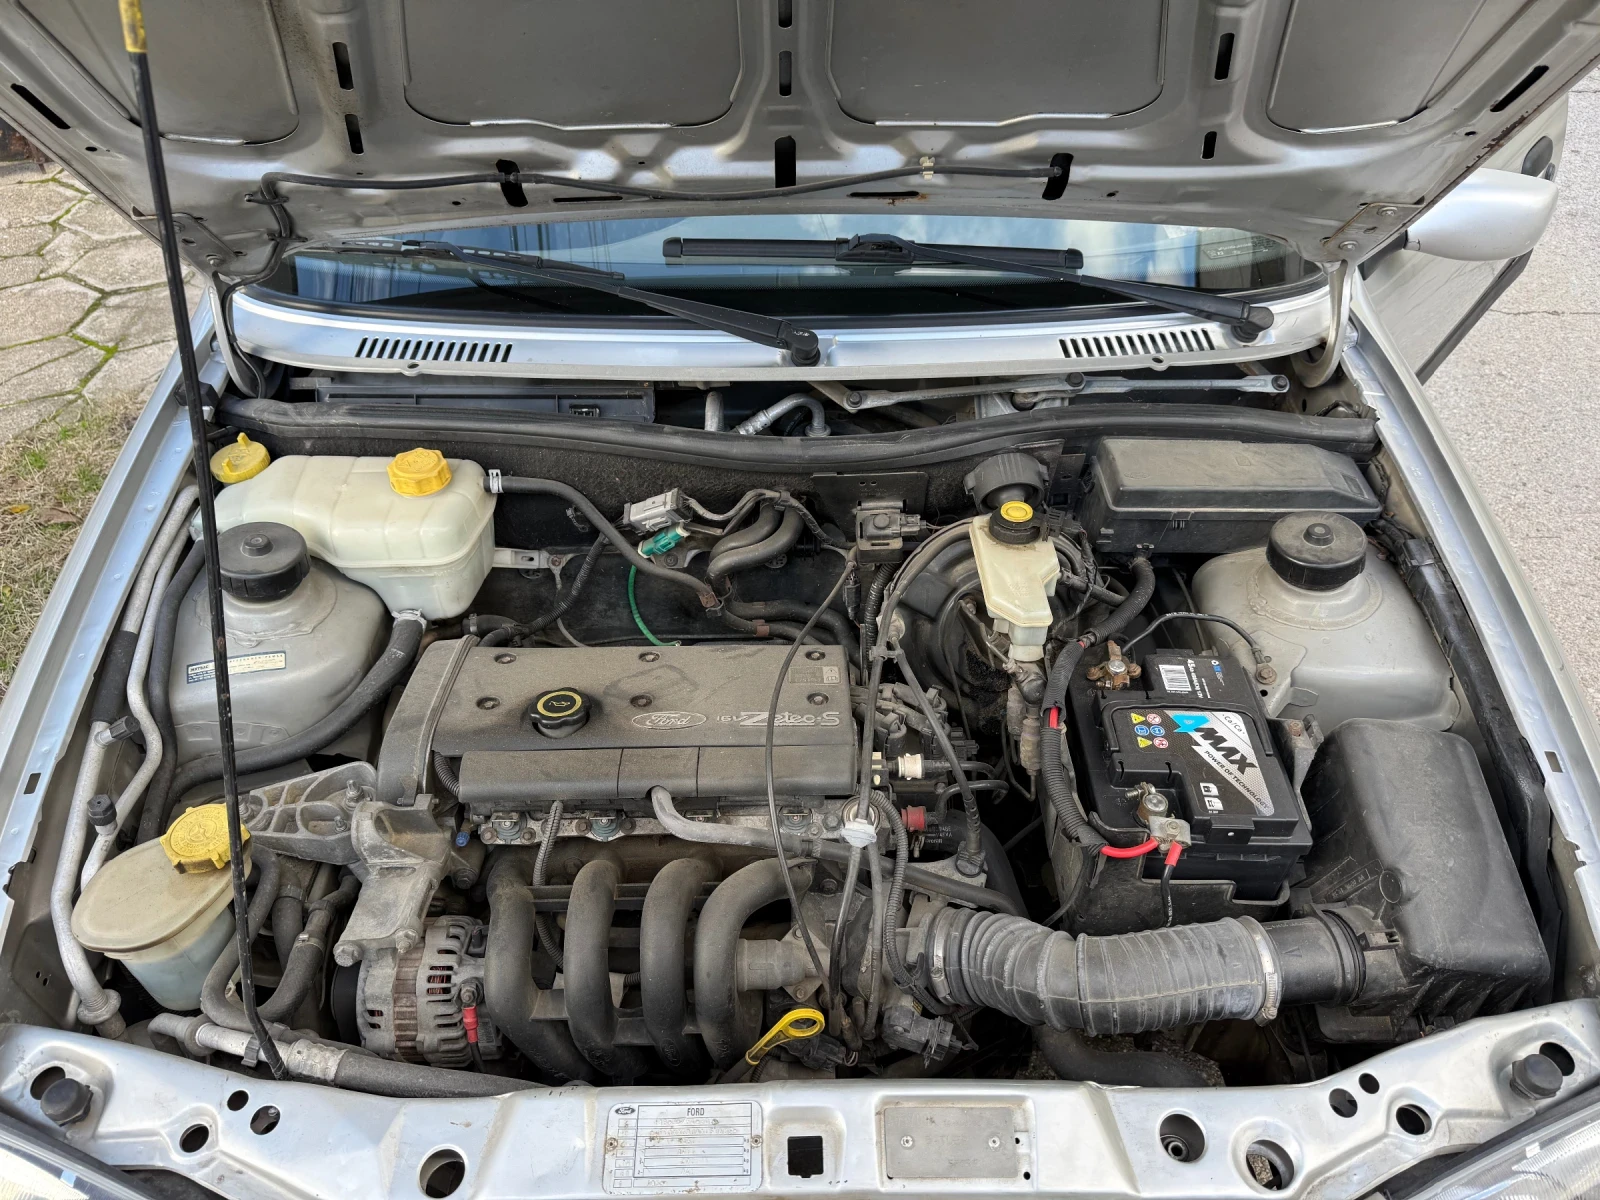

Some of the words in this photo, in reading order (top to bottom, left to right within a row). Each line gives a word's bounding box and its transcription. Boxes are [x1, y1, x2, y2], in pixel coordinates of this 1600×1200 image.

[645, 713, 692, 726] Ford
[1224, 714, 1244, 733] Ca/Ca
[1204, 750, 1225, 769] POWER
[1224, 768, 1233, 777] OF
[1232, 775, 1270, 809] TECHNOLOGY
[686, 1107, 705, 1116] FORD
